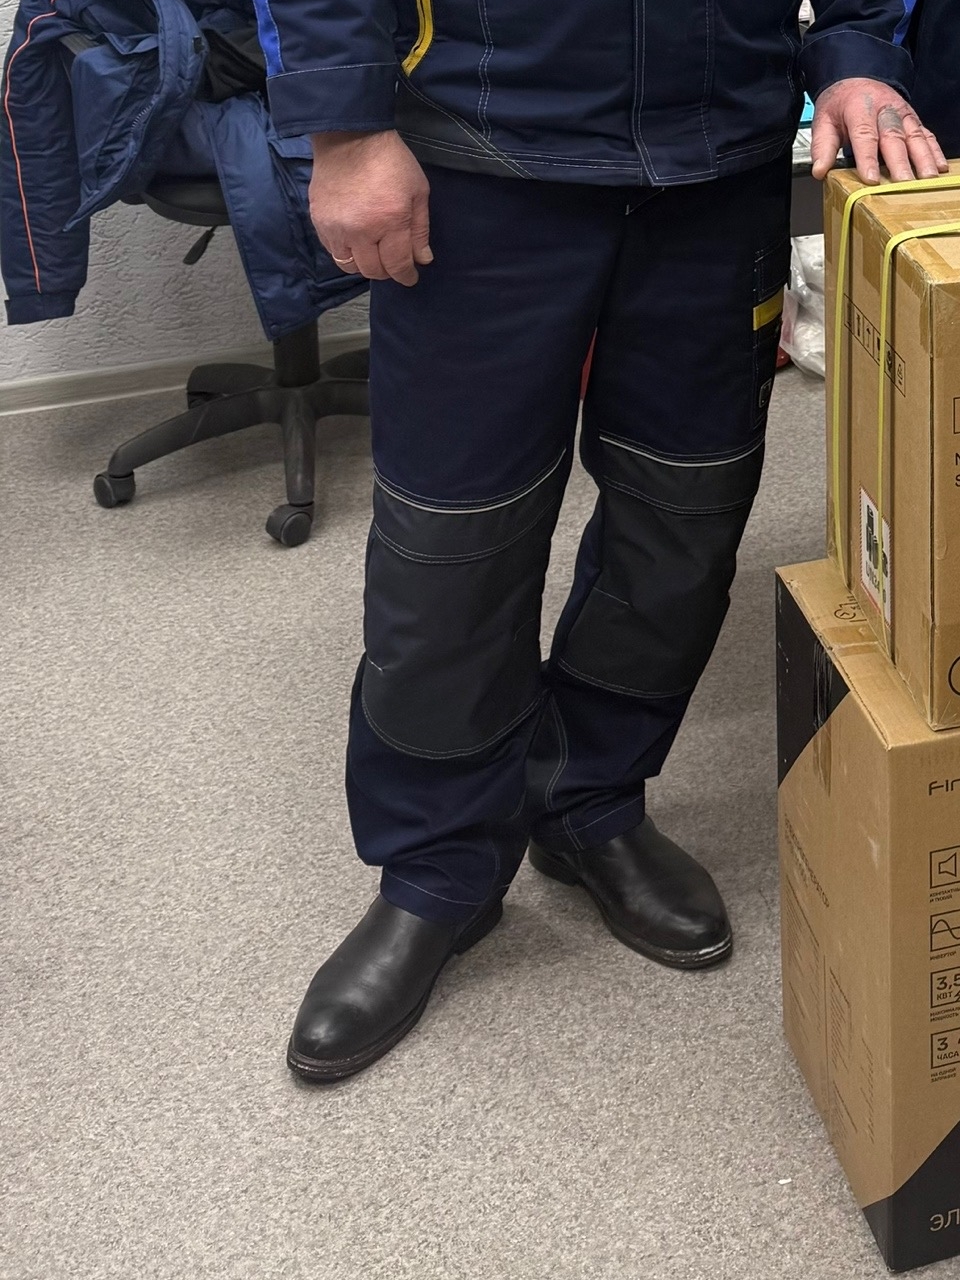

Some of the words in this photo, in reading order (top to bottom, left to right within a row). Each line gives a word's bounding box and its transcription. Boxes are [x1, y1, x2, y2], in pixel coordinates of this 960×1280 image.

[936, 991, 953, 1000] КВТ
[937, 1037, 948, 1051] 3
[937, 1050, 959, 1061] ЧАСА
